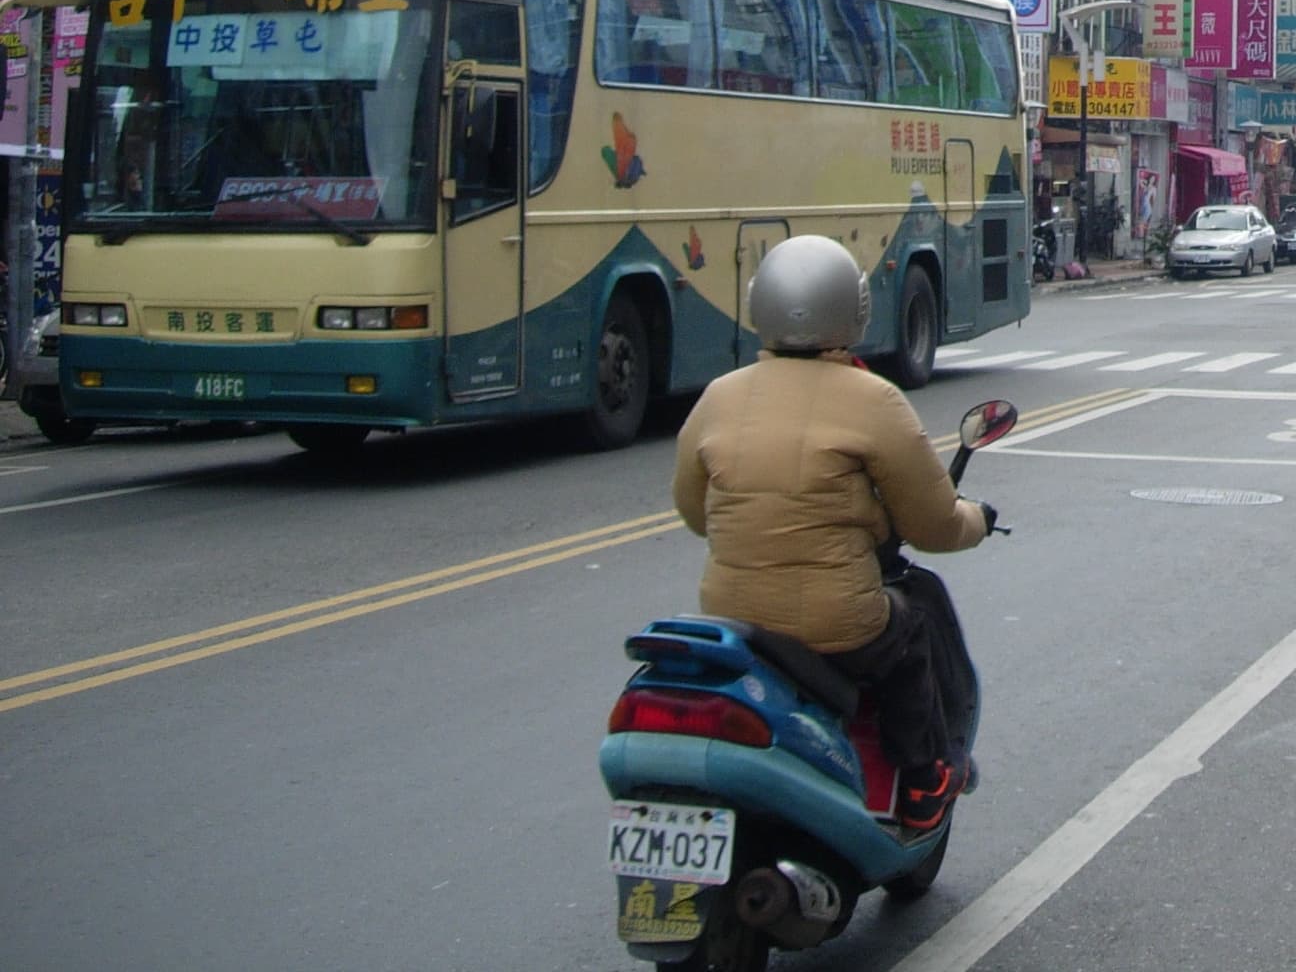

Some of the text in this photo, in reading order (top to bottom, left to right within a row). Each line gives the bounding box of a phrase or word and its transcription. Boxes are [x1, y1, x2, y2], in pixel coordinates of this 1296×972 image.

[173, 19, 323, 54] 中投草屯
[1052, 101, 1076, 115] 電話
[167, 311, 275, 333] 南投客運
